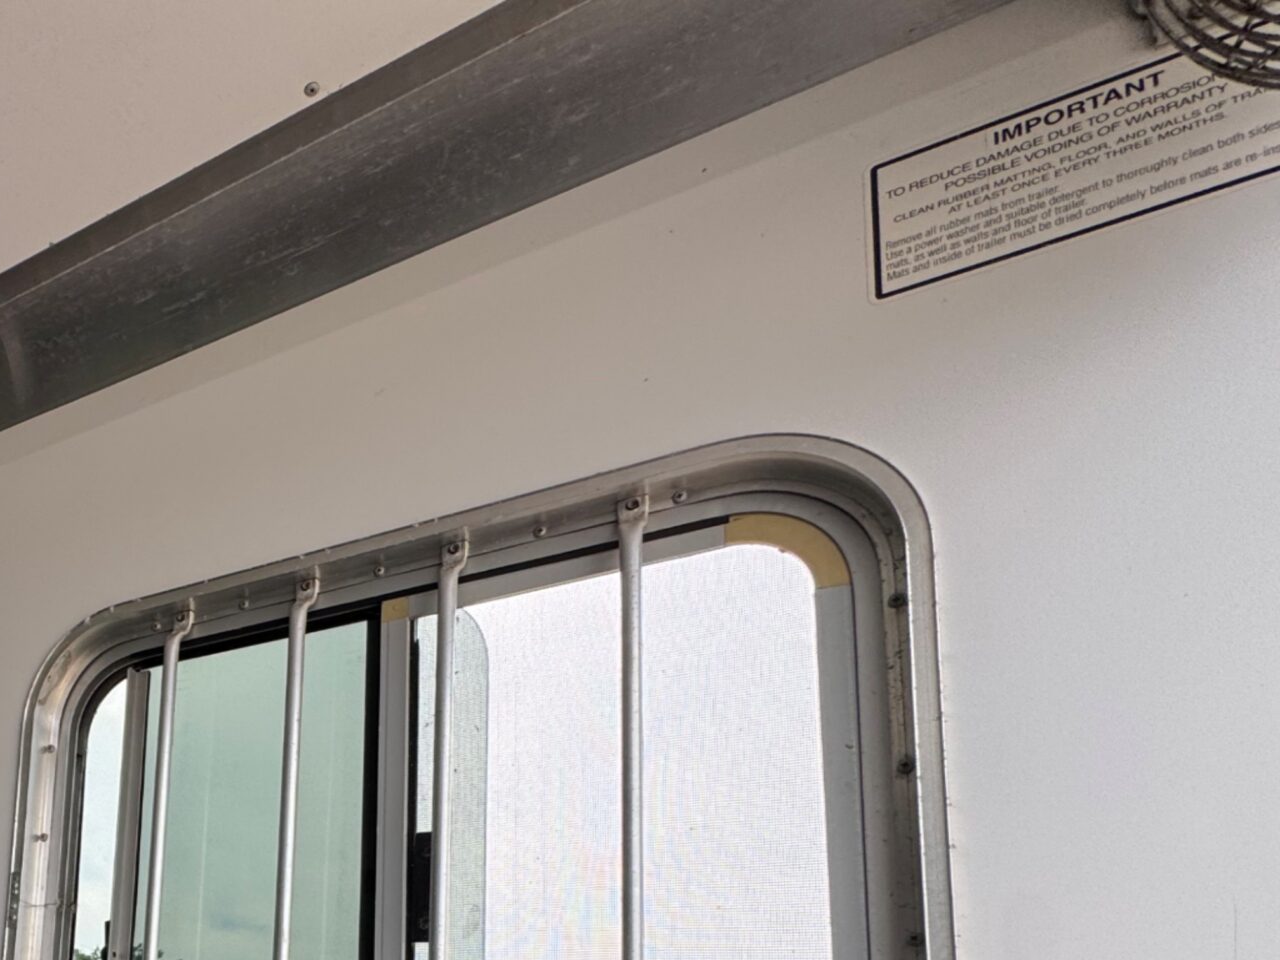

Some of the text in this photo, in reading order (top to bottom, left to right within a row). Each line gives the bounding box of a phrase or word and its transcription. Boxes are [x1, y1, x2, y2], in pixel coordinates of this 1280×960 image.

[944, 82, 1228, 192] POSSIBLE VOIDING OF WARRANTY
[993, 69, 1165, 145] IMPORTANT
[885, 186, 906, 199] TO
[908, 161, 972, 192] REDUCE
[975, 135, 1043, 168] DAMAGE
[1047, 121, 1082, 141] DUE
[1088, 113, 1109, 126] TO
[885, 249, 904, 261] Use
[906, 246, 912, 254] a
[914, 236, 943, 253] power
[946, 223, 980, 240] washer
[983, 214, 1003, 229] and
[1005, 200, 1046, 220] suitable
[1048, 181, 1100, 207] detergent
[1101, 178, 1113, 189] to
[1116, 155, 1179, 184] thoroughly
[1182, 143, 1214, 161] clean
[1217, 132, 1245, 150] both
[893, 203, 935, 223] CLEAN
[937, 183, 990, 208] RUBBER
[1116, 129, 1147, 144] AND
[1150, 109, 1201, 132] WALLS
[1205, 99, 1227, 114] OF
[1231, 87, 1266, 103] TRA
[948, 202, 964, 215] AT
[966, 186, 1009, 208] LEAST
[1011, 173, 1049, 193] ONCE
[1054, 155, 1100, 178] EVERY
[1103, 136, 1153, 159] THREE
[885, 232, 923, 250] Remove
[925, 225, 937, 238] all
[939, 215, 971, 232] rubber
[974, 206, 999, 220] mats
[1001, 197, 1025, 211] from
[886, 144, 1280, 281] Mats and inside of trailer must be dried completely before mats are re-ins
[914, 252, 926, 262] as
[927, 243, 947, 258] well
[950, 242, 962, 251] as
[963, 230, 989, 246] walls
[991, 222, 1012, 236] and
[1014, 213, 1038, 228] floor
[1041, 208, 1052, 221] of
